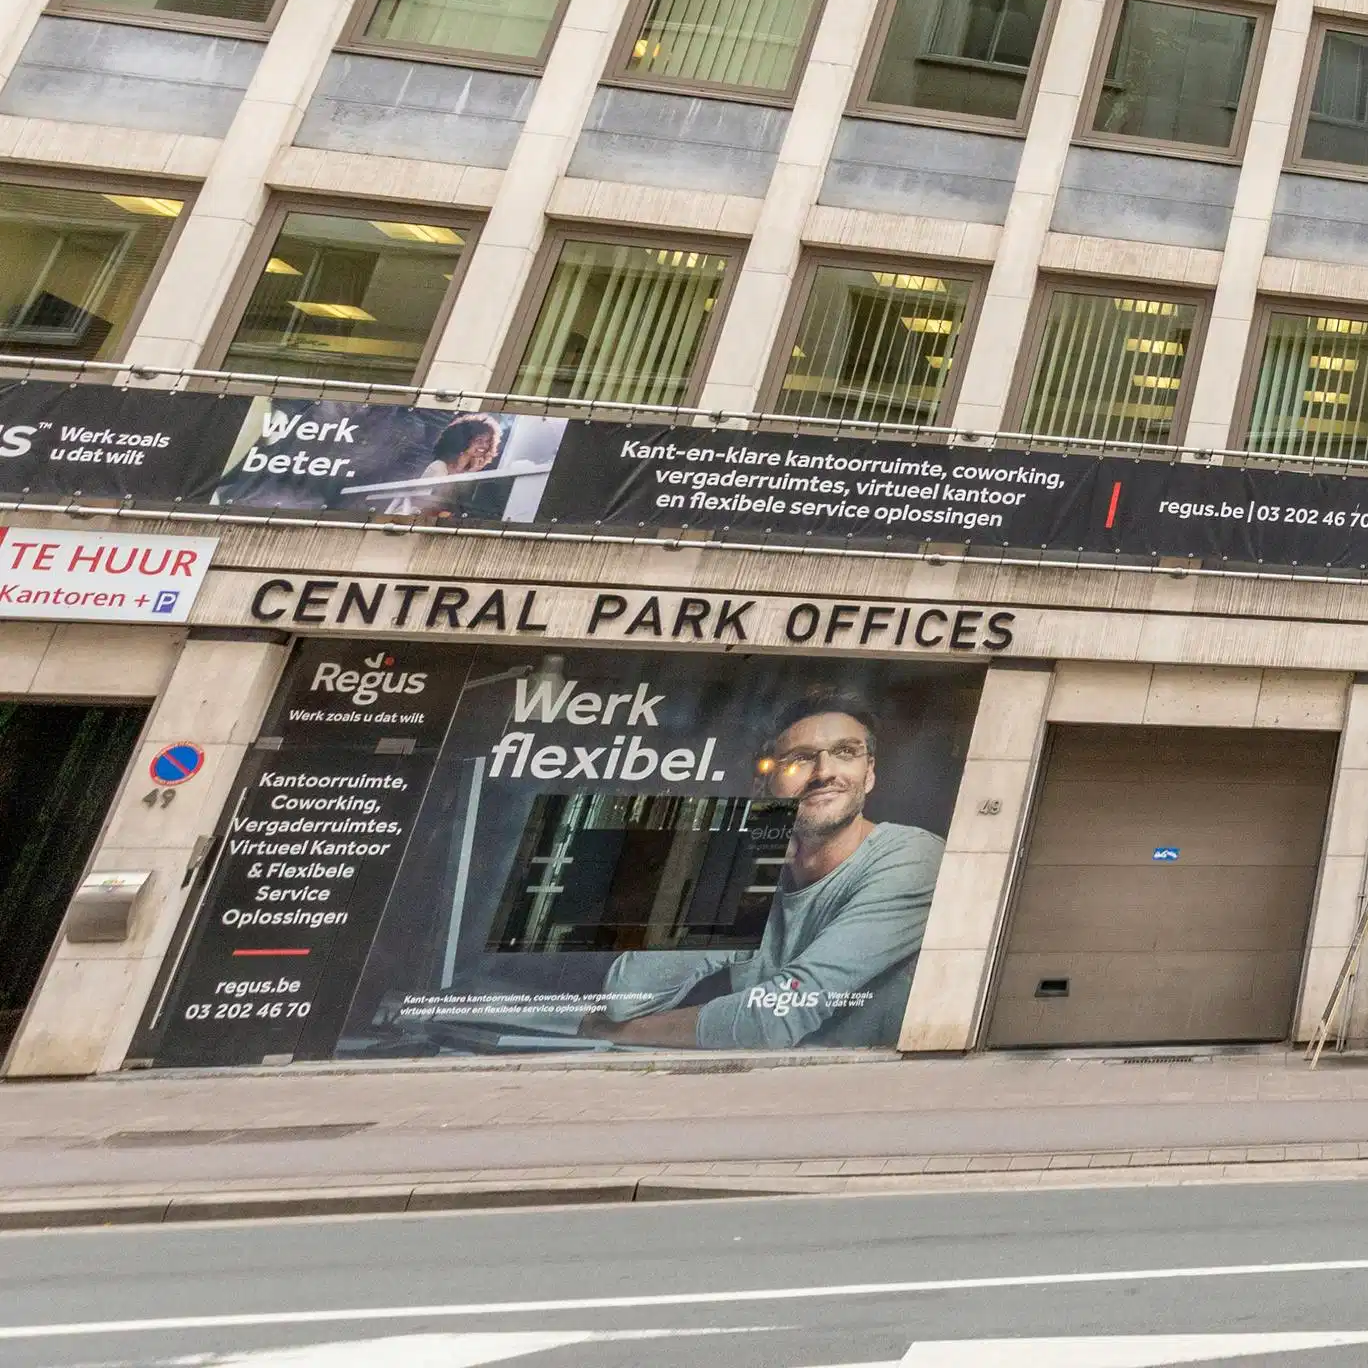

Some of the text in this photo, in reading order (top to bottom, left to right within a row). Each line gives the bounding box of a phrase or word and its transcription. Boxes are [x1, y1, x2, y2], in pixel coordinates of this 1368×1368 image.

[60, 426, 170, 449] Werk zoals
[261, 413, 360, 443] Werk
[50, 447, 145, 466] u dat wilt
[243, 447, 356, 478] beter.
[620, 440, 1065, 489] Kant-en-klare kantoorruimte, coworking,
[655, 468, 1025, 506] vergaderruimtes, virtueel kantoor
[656, 491, 1003, 529] en flexibele service oplossingen
[1158, 499, 1244, 521] regus.be
[1256, 508, 1278, 523] 03
[1283, 509, 1319, 524] 202
[1322, 511, 1346, 525] 46
[10, 542, 198, 577] TE HUUR
[0, 585, 125, 608] Kantoren
[250, 578, 1016, 650] CENTRAL PARK OFFICES
[310, 662, 428, 706] Regus
[512, 678, 667, 726] Werk
[288, 710, 424, 724] Werk zoals u dat wilt
[488, 732, 727, 782] flexibel.
[258, 772, 409, 791] Kantoorruimte,
[271, 794, 382, 814] Coworking,
[232, 817, 403, 836] Vergaderruimtes,
[228, 839, 390, 856] Virtueel Kantoor
[247, 863, 355, 878] & Flexibele
[255, 886, 330, 901] Service
[221, 908, 348, 928] Oplossingen
[215, 976, 301, 998] regus.be
[827, 991, 873, 1000] Werk zoals
[184, 1000, 311, 1019] 03 202 46 70
[400, 1006, 435, 1016] virtueel
[435, 1006, 471, 1014] kantoor
[555, 1003, 608, 1014] oplossingen
[403, 995, 466, 1005] Kant-en-klare
[467, 994, 532, 1004] kantoorruimte,
[533, 995, 581, 1003] coworking,
[747, 987, 819, 1017] Regus
[831, 999, 848, 1007] dat
[848, 999, 865, 1007] wilt
